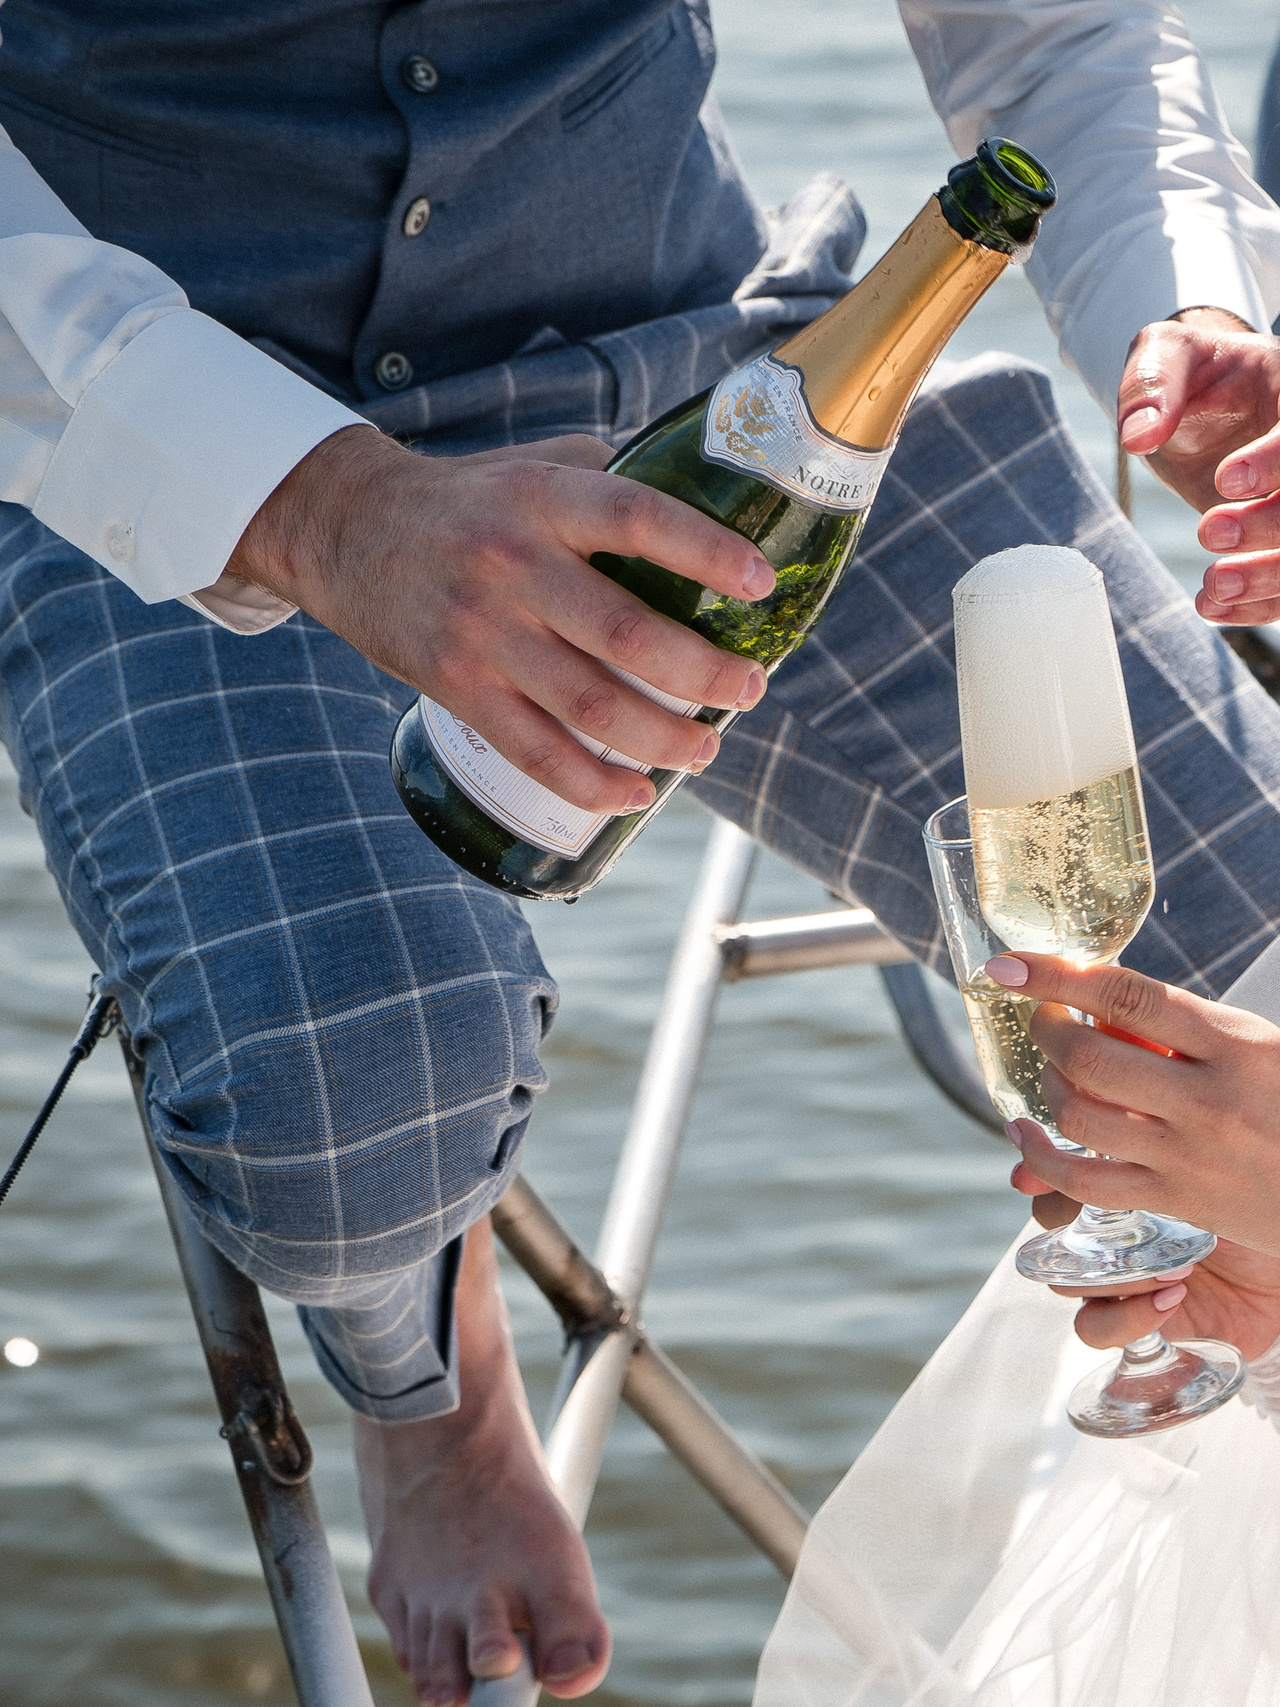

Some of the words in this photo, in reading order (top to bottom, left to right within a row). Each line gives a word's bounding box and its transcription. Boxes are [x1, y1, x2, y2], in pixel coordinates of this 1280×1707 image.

[773, 385, 784, 399] EN
[781, 399, 804, 442] FRANCE
[791, 465, 863, 499] NOTRE
[432, 702, 448, 735] ODUIT
[449, 738, 460, 752] EN
[461, 754, 497, 793] FRANCE
